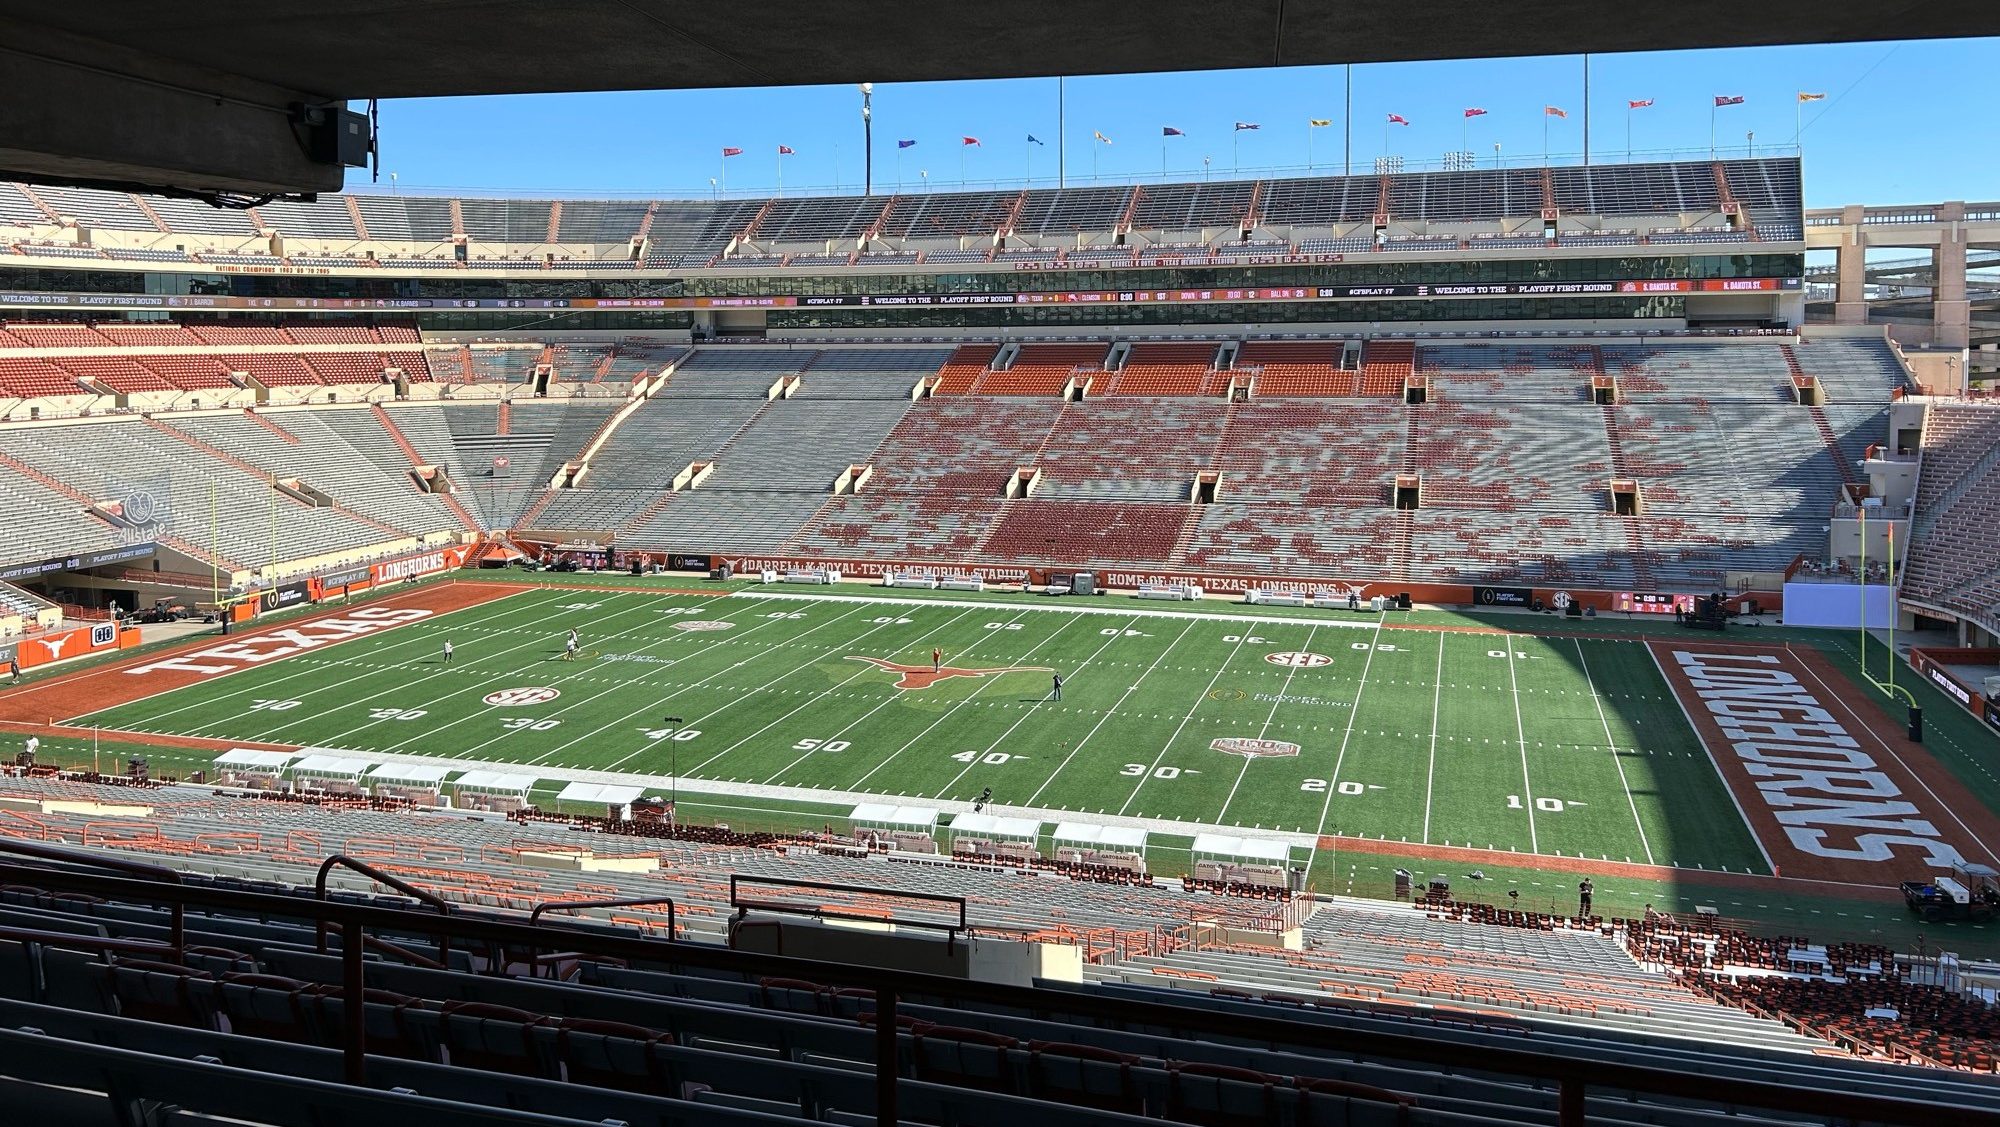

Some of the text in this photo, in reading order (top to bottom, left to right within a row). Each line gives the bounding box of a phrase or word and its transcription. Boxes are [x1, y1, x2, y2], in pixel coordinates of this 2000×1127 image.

[136, 297, 162, 305] ROUND
[118, 522, 167, 543] Allstate
[93, 548, 154, 563] PLAYOFF FIRST ROUND
[42, 563, 62, 572] ROUND
[67, 559, 80, 568] 0:00
[377, 553, 446, 581] LONGHORNS
[748, 560, 799, 573] DARRELL
[904, 565, 968, 578] MEMORIAL
[973, 568, 1030, 580] STADIUM
[1107, 574, 1336, 594] HOME OF THE TEXAS LONGHORNS
[1554, 592, 1570, 608] SEC
[1643, 594, 1656, 602] 0:00
[1100, 628, 1142, 636] 40
[124, 607, 435, 675] TEXAS
[1222, 636, 1266, 644] 30
[1350, 642, 1396, 651] 20
[1272, 652, 1331, 666] SEC
[1487, 650, 1526, 659] 10
[487, 688, 557, 706] SEC
[250, 700, 303, 710] 10
[368, 708, 428, 720] 20
[503, 718, 561, 730] 30
[645, 728, 702, 740] 40
[792, 738, 852, 752] 50
[951, 750, 1010, 765] 40
[1671, 650, 1968, 868] LONGHORNS
[1119, 763, 1181, 779] 30
[1300, 778, 1364, 796] 20
[1506, 795, 1564, 812] 10
